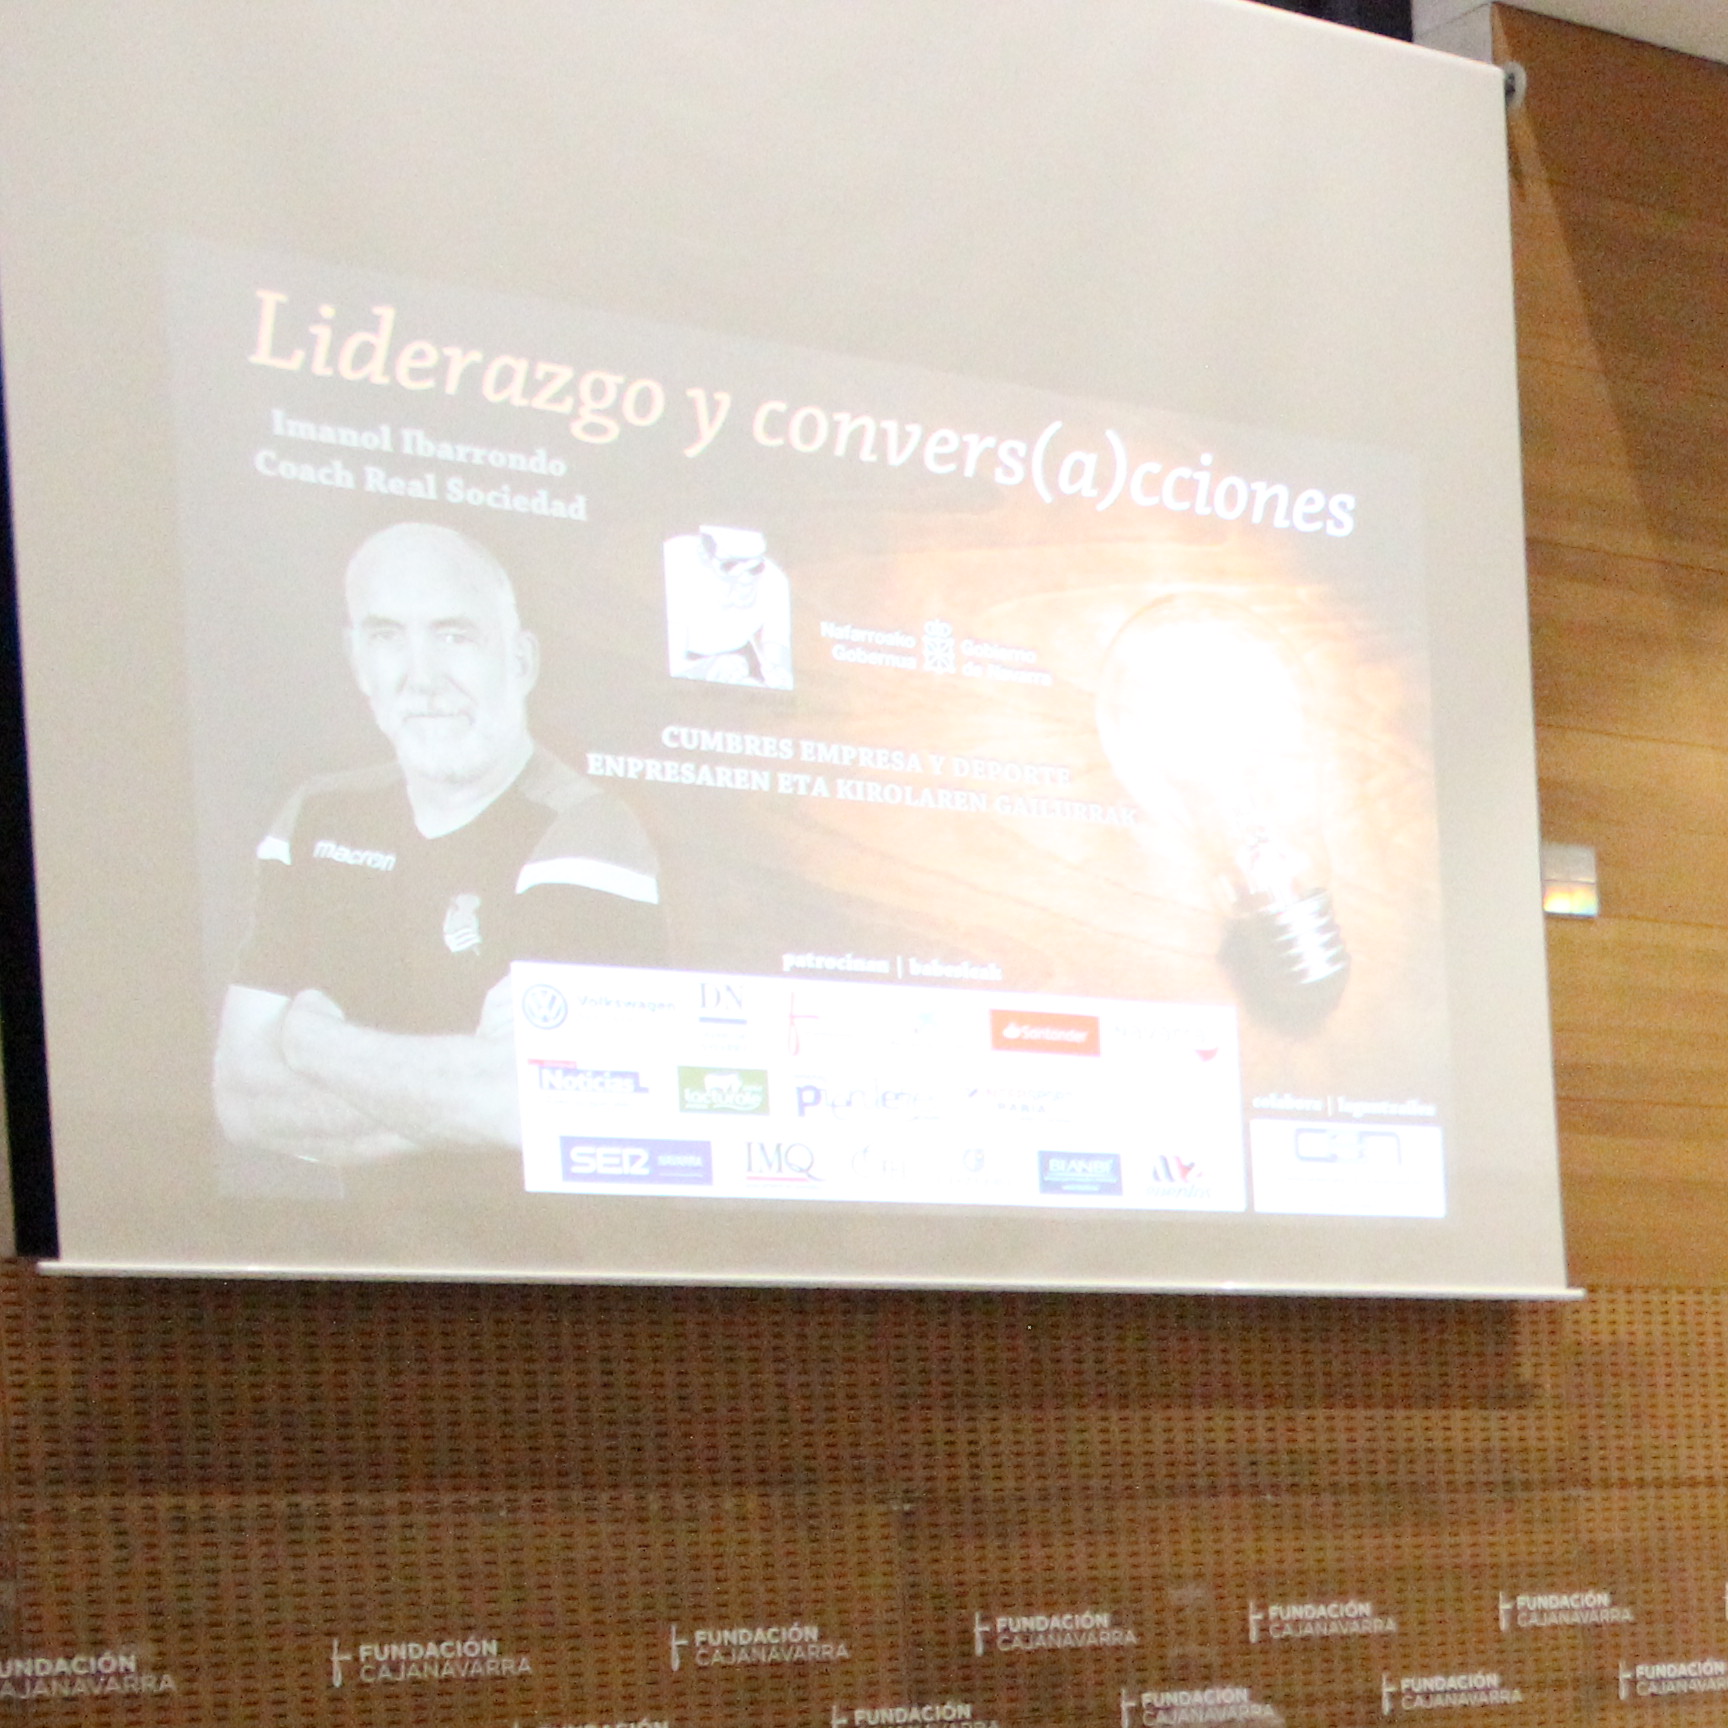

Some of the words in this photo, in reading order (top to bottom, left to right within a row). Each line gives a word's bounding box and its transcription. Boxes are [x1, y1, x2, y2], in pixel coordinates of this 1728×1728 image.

[248, 288, 665, 444] Liderazgo
[682, 385, 731, 457] y
[752, 398, 1356, 539] convers(a)cciones
[271, 407, 392, 452] Imanol
[400, 428, 568, 478] Ibarrondo
[254, 448, 356, 490] Coach
[364, 464, 438, 501] Real
[445, 475, 589, 521] Sociedad
[661, 725, 794, 761] CUMBRES
[800, 740, 922, 774] EMPRESA
[928, 755, 947, 776] Y
[953, 757, 1072, 790] DEPORTE
[586, 752, 771, 793] ENPRESAREN
[778, 773, 830, 799] ETA
[836, 778, 989, 814] KIROLAREN
[313, 839, 397, 872] macron
[782, 952, 891, 974] patrocinan
[541, 1069, 635, 1094] Noticias
[570, 1146, 649, 1175] SER
[1269, 1600, 1372, 1621] FUNDACIÓN
[1517, 1589, 1609, 1610] FUNDACIÓN
[996, 1610, 1110, 1633] FUNDACIÓN
[1270, 1618, 1397, 1640] CAJANAVARRA
[1518, 1606, 1635, 1628] CAJANAVARRA
[695, 1622, 819, 1645] FUNDACIÓN
[997, 1629, 1138, 1652] CAJANAVARRA
[359, 1637, 498, 1664] FUNDACIÓN
[696, 1642, 850, 1668] CAJANAVARRA
[0, 1652, 136, 1678] UNDACIÓN
[360, 1655, 532, 1683] CAJANAVARRA
[1635, 1658, 1725, 1680] FUNDACIÓN
[0, 1673, 175, 1700] AJANAVARRA
[1400, 1671, 1499, 1692] FUNDACIÓN
[1141, 1686, 1250, 1707] FUNDACIÓN
[1401, 1688, 1523, 1711] CAJANAVARRA
[854, 1700, 972, 1725] FUNDACIÓN
[1142, 1703, 1276, 1728] CAJANAVARRA
